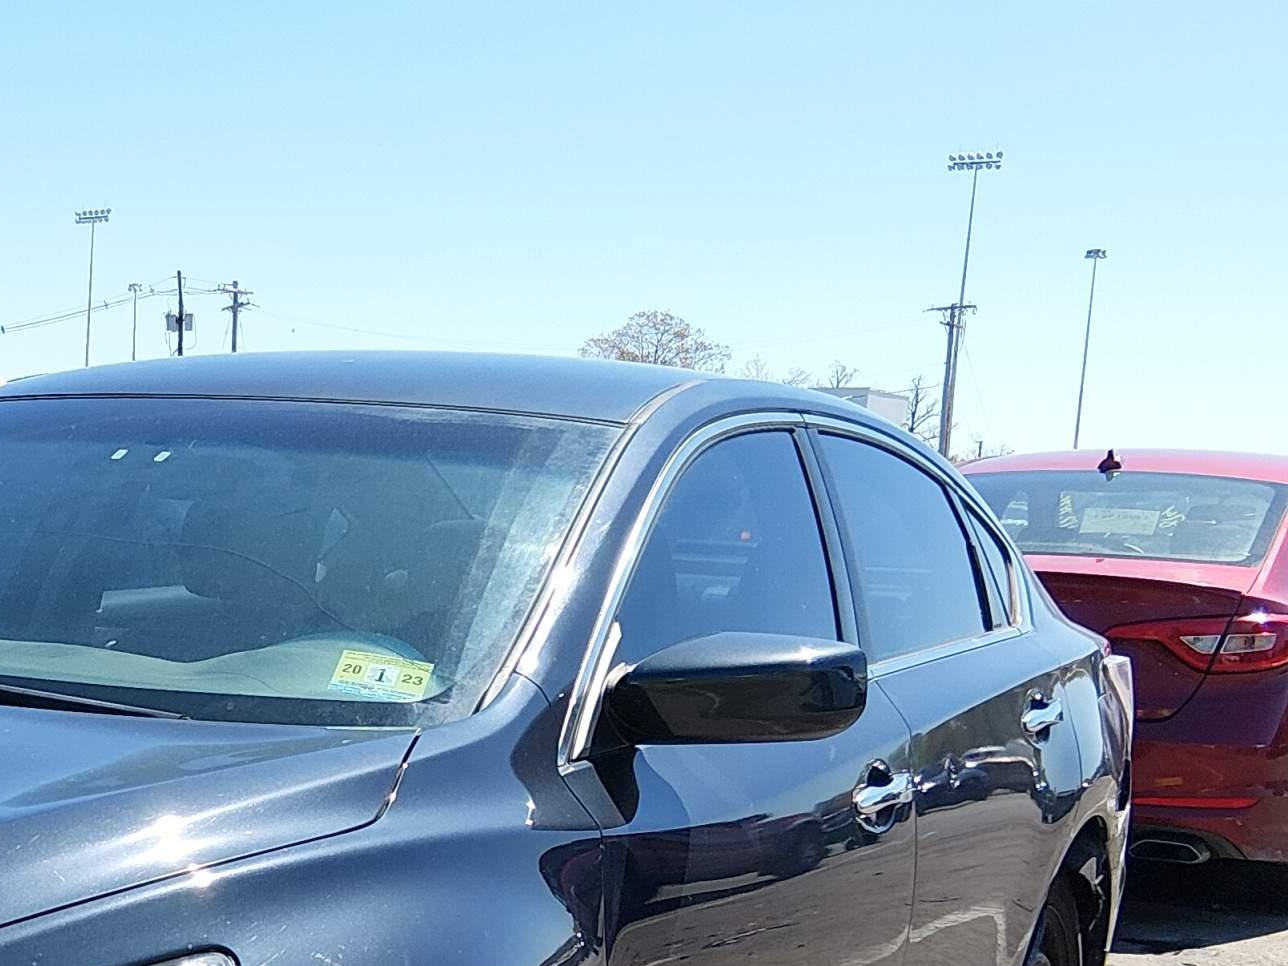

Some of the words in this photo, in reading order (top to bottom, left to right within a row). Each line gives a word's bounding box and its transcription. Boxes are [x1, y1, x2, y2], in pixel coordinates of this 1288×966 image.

[342, 663, 362, 675] 20
[374, 668, 386, 683] 1
[401, 673, 424, 686] 23
